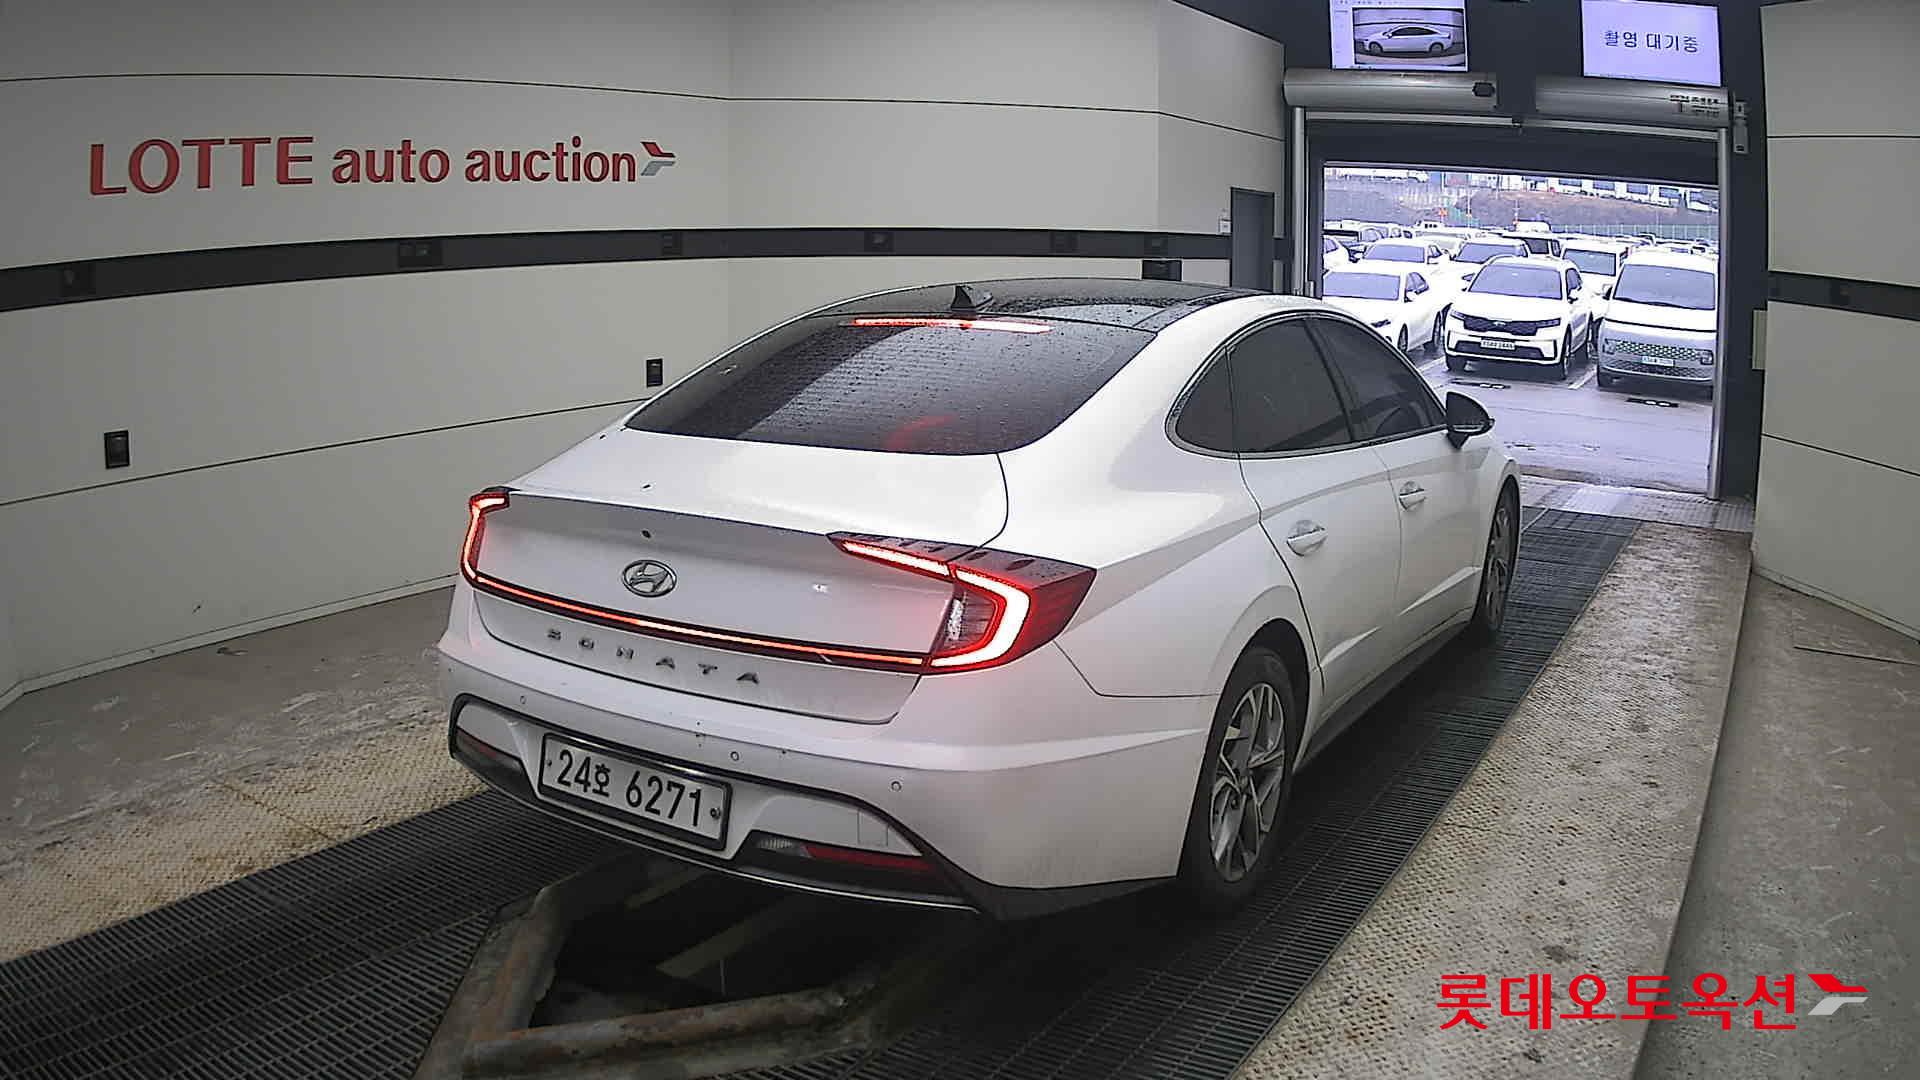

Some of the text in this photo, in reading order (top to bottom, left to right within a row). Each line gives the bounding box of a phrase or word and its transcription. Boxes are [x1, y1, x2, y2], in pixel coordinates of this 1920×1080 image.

[1604, 30, 1698, 53] 촬영 대기중
[89, 135, 637, 195] LOTTE auto auction
[547, 628, 760, 685] SONATA
[557, 749, 702, 828] 24호 6271
